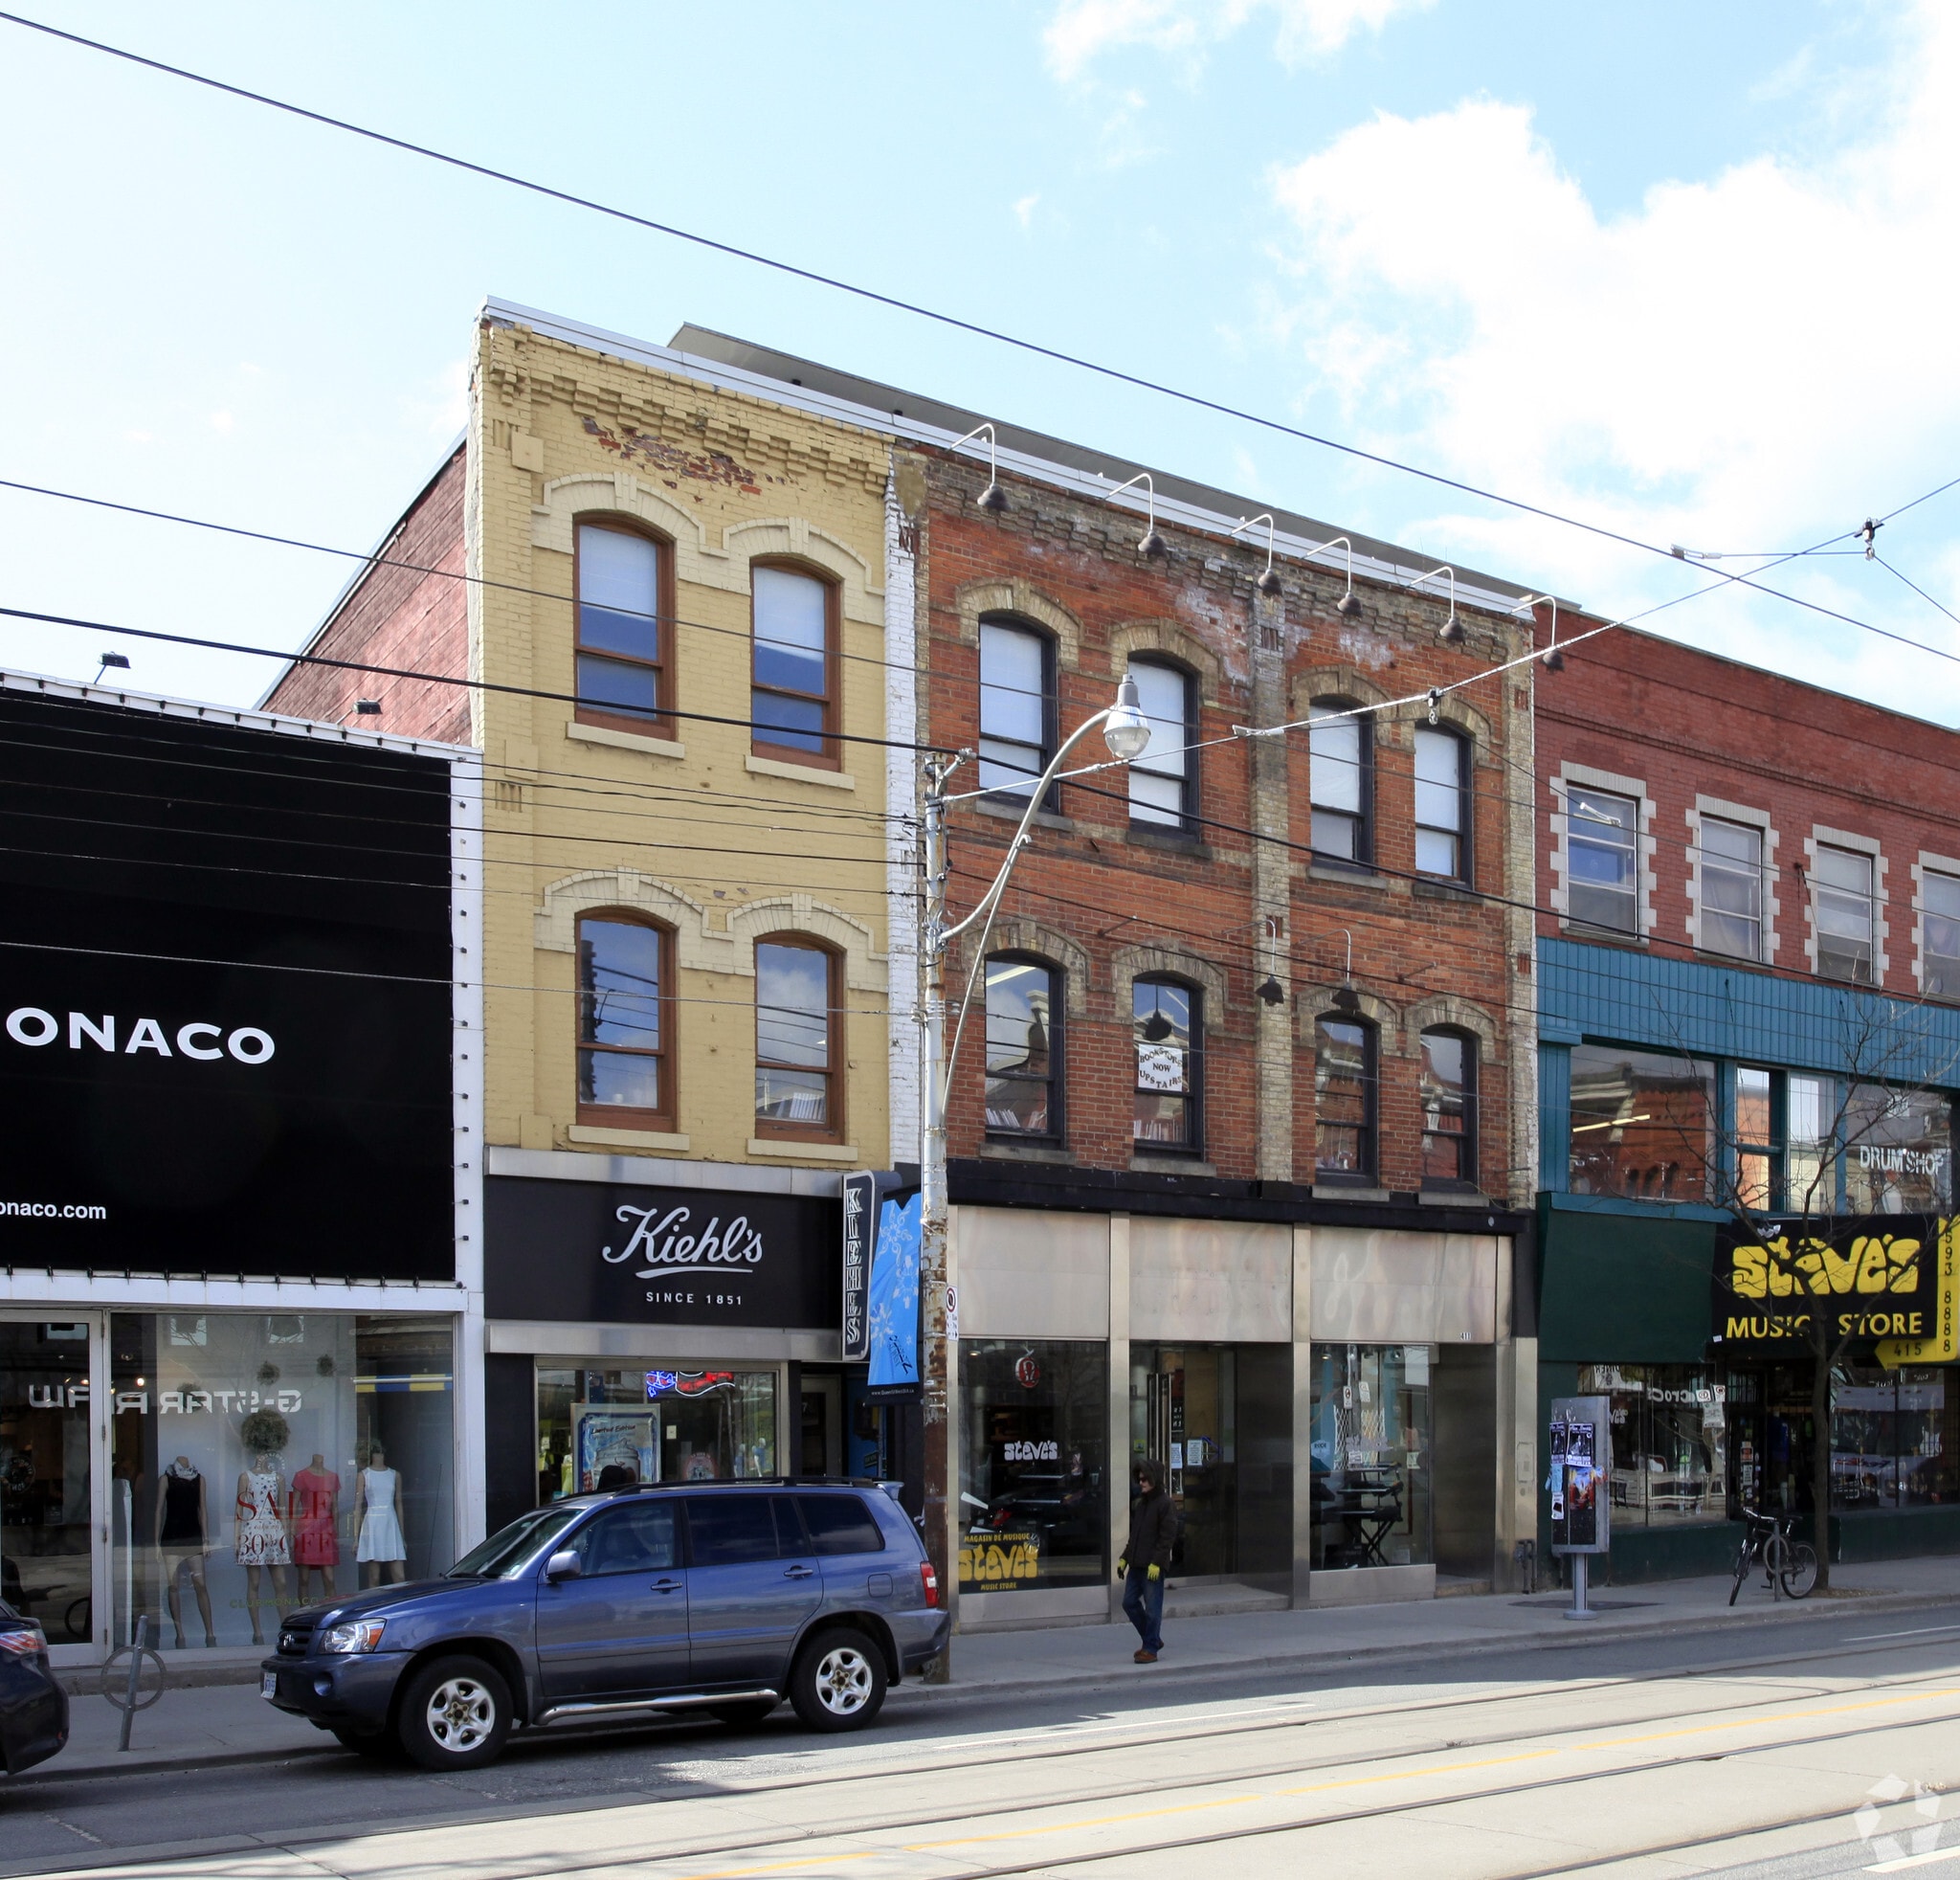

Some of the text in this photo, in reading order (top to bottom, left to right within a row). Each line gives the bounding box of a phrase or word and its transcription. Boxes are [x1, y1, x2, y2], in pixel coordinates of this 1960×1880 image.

[6, 1007, 276, 1064] ONACO
[1152, 1063, 1171, 1072] NOW
[1140, 1070, 1182, 1088] UPSTAIRS
[1860, 1145, 1944, 1175] DRUM SHOP
[602, 1204, 764, 1264] Kiehl's
[646, 1291, 743, 1306] SINCE 1851
[1726, 1312, 1923, 1339] MUSIC STORE
[1894, 1342, 1922, 1356] 415
[591, 1423, 636, 1435] Limited Edition
[236, 1490, 334, 1521] SALE
[238, 1533, 333, 1555] 30% OFF
[1002, 1533, 1031, 1541] MUSIQUE
[998, 1581, 1017, 1590] STORE
